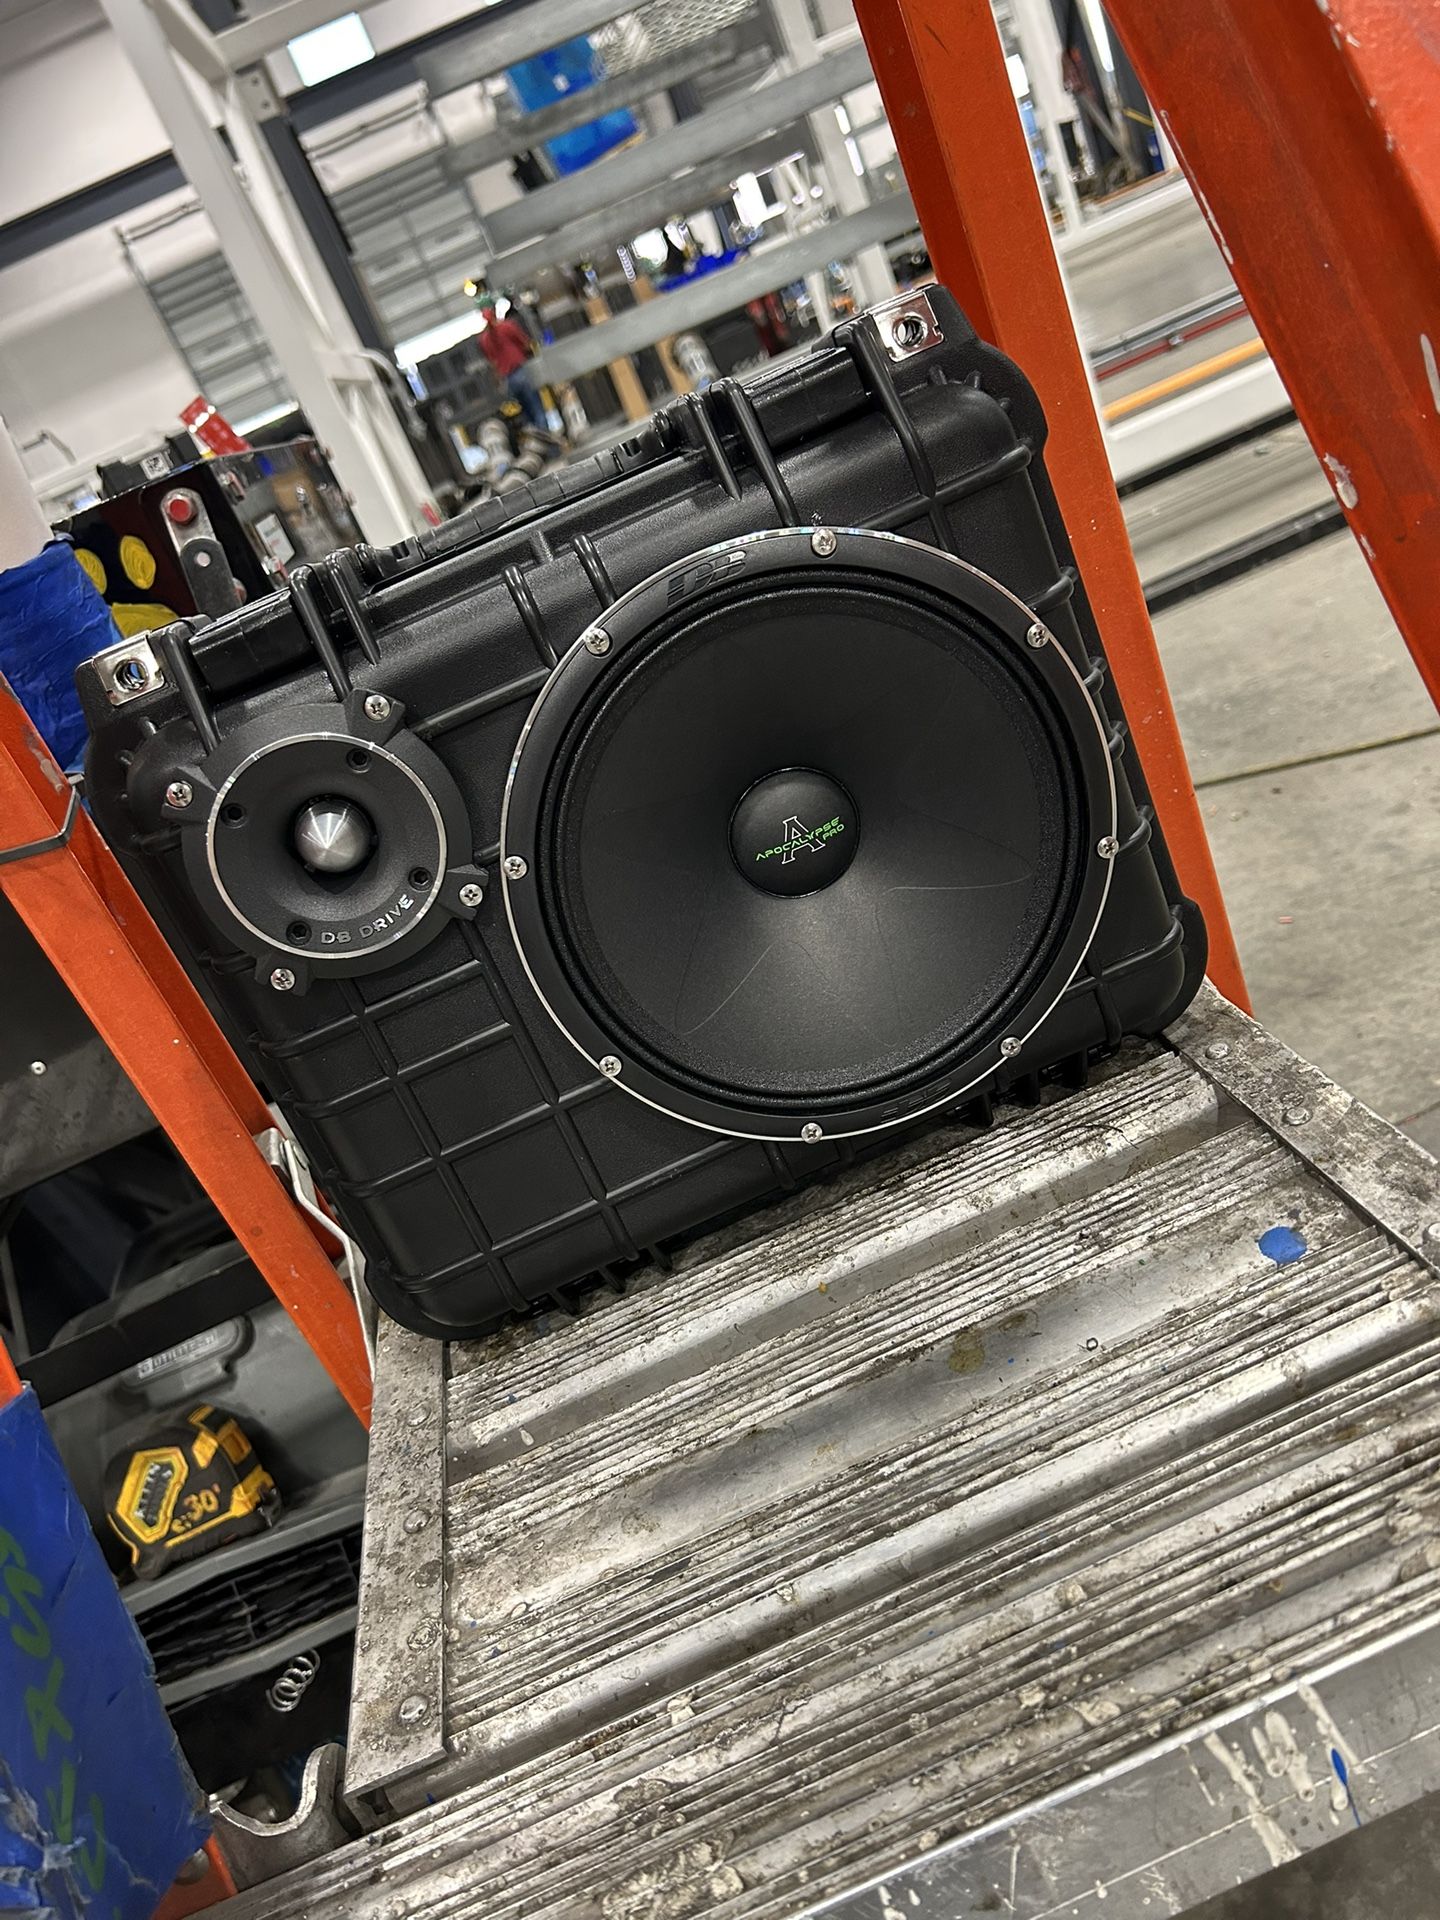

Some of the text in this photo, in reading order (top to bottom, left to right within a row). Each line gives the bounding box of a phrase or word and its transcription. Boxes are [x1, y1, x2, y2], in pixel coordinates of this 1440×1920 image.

[755, 816, 841, 861] APOCALYPSE
[822, 823, 845, 841] PRO
[320, 893, 415, 944] DB DRIVE
